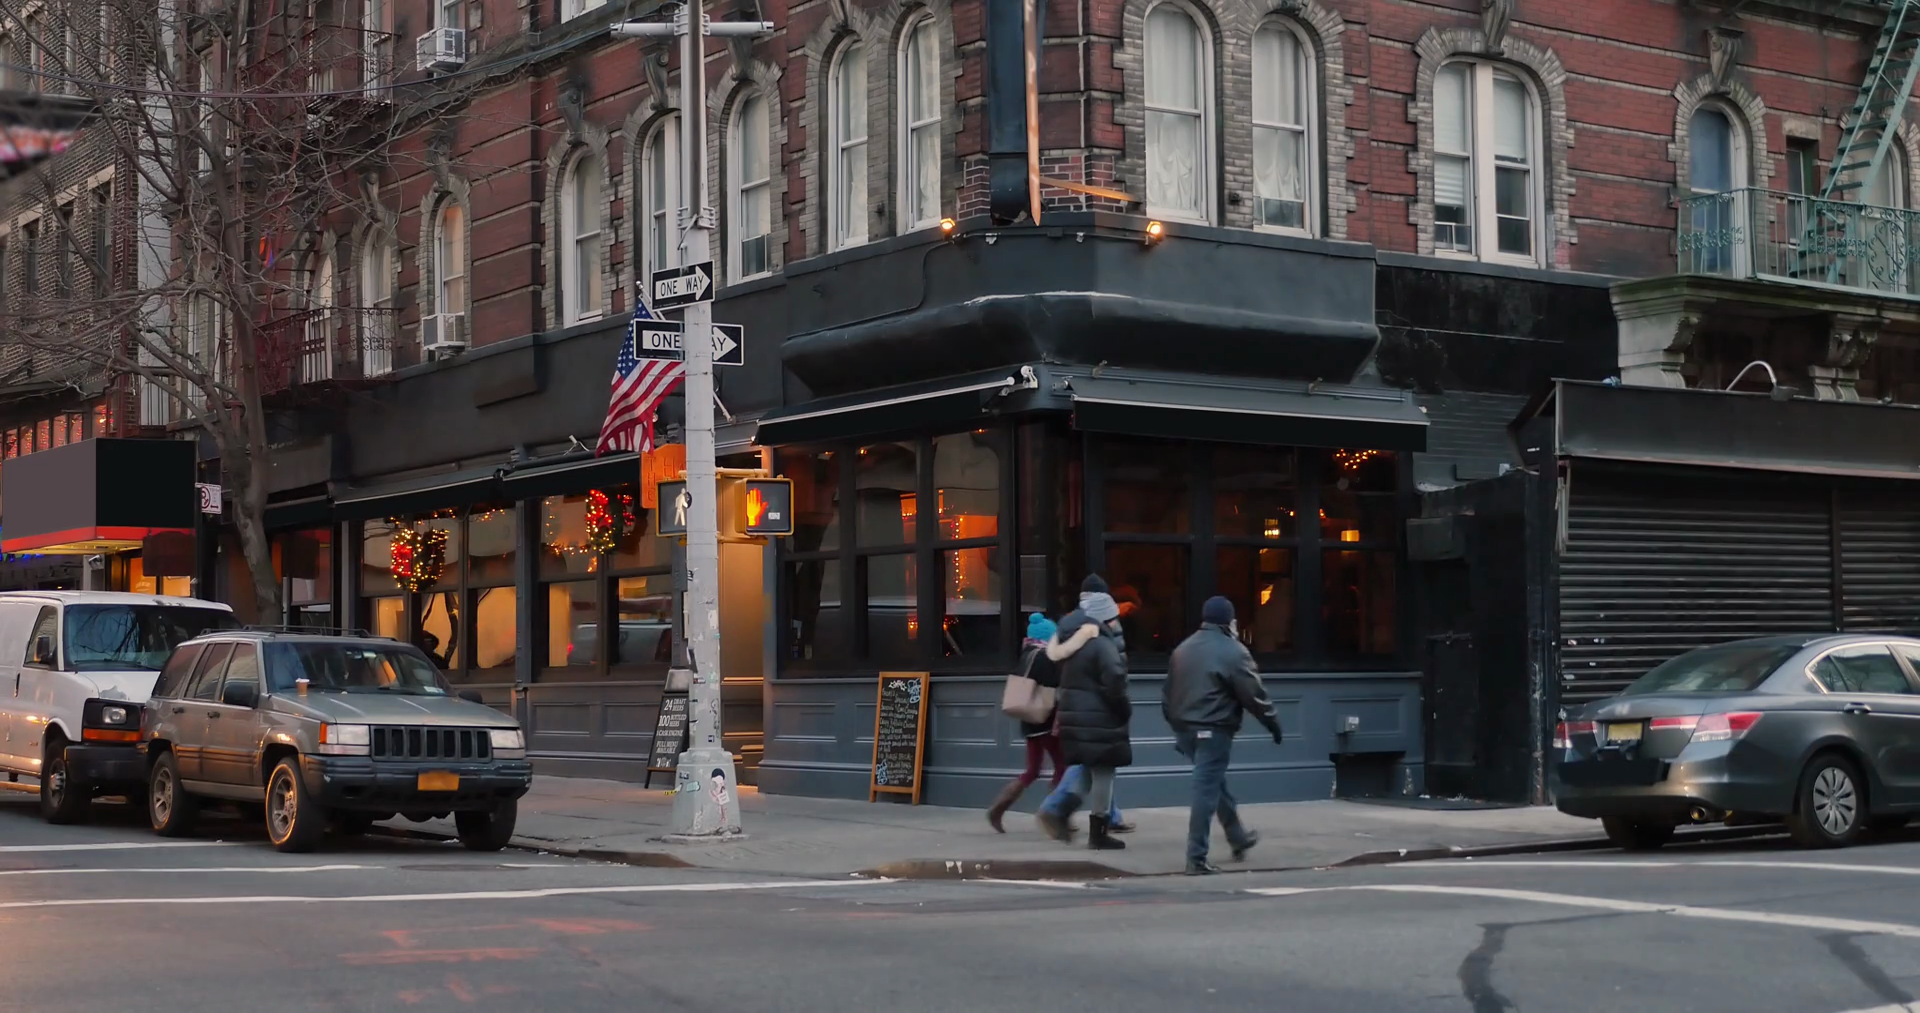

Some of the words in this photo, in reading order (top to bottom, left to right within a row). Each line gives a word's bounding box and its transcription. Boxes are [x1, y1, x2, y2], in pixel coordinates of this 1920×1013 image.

[660, 280, 678, 297] ONE
[685, 274, 704, 292] WAY
[651, 333, 682, 348] ONE
[711, 336, 727, 351] AY
[664, 699, 674, 711] 24
[658, 715, 671, 727] 100
